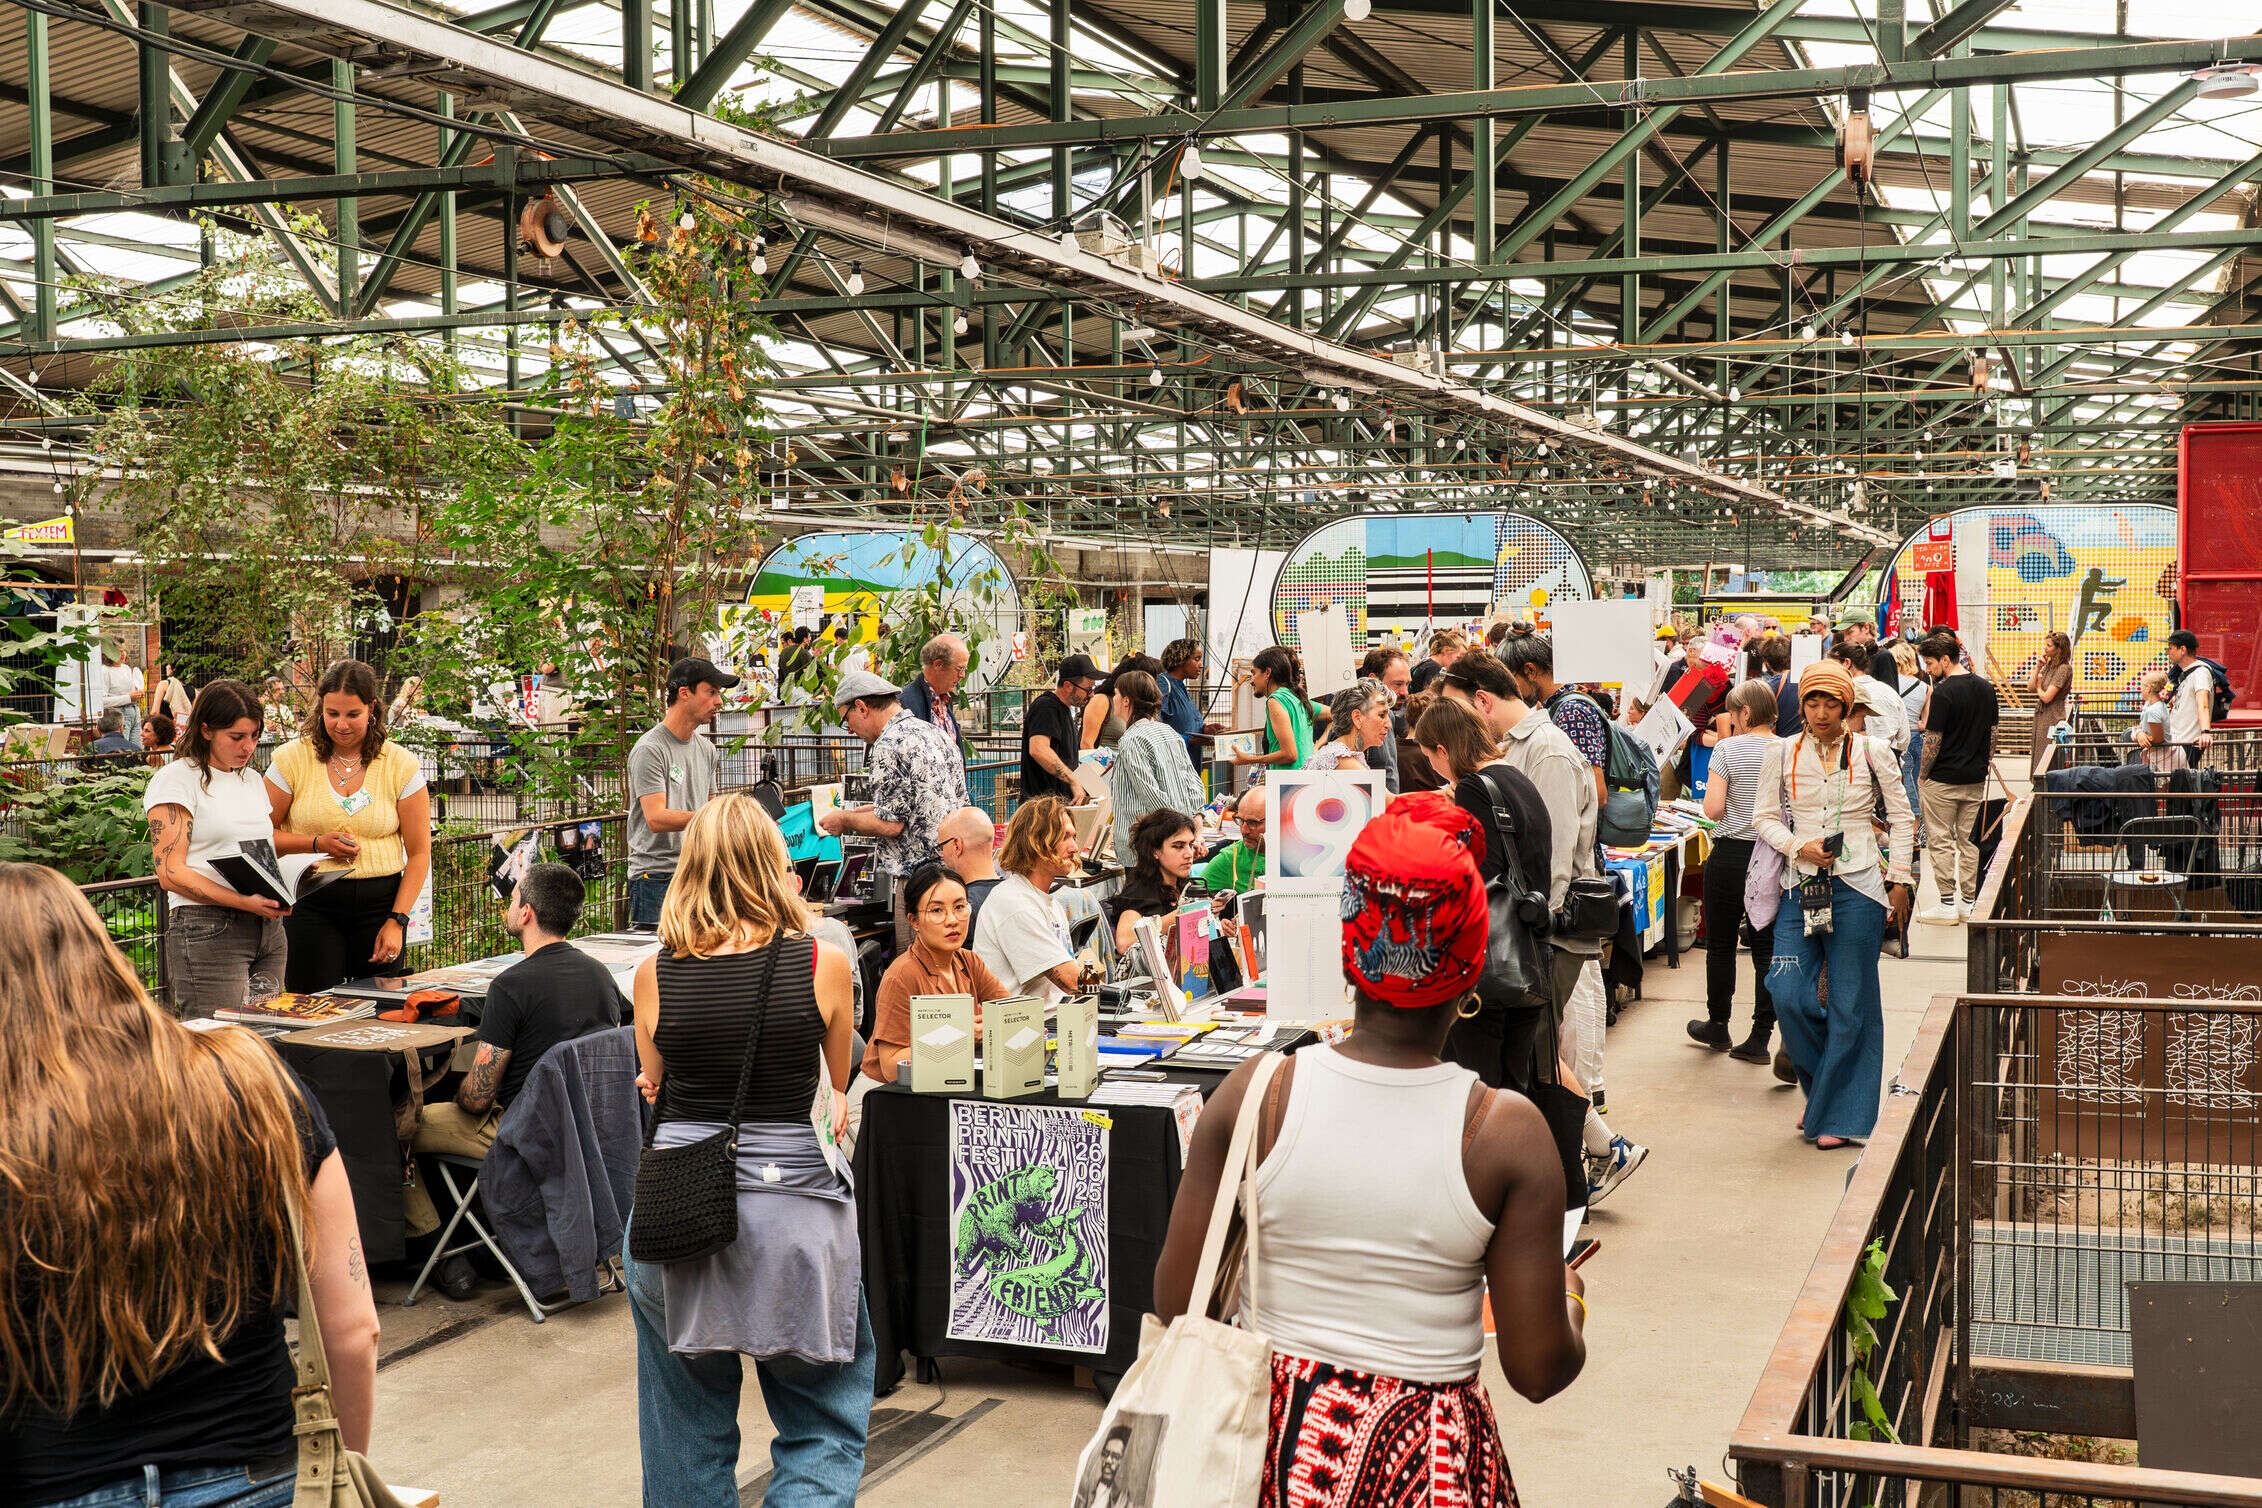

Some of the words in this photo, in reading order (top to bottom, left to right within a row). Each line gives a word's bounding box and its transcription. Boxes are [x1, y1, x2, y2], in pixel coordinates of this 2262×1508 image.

[957, 1106, 1042, 1130] BERLIN
[957, 1125, 1028, 1151] PRINT
[957, 1145, 1067, 1171] FESTIVAL
[1075, 1142, 1103, 1163] 26
[1075, 1161, 1103, 1182] 06
[966, 1173, 1023, 1223] PRINT
[1075, 1181, 1102, 1202] 25
